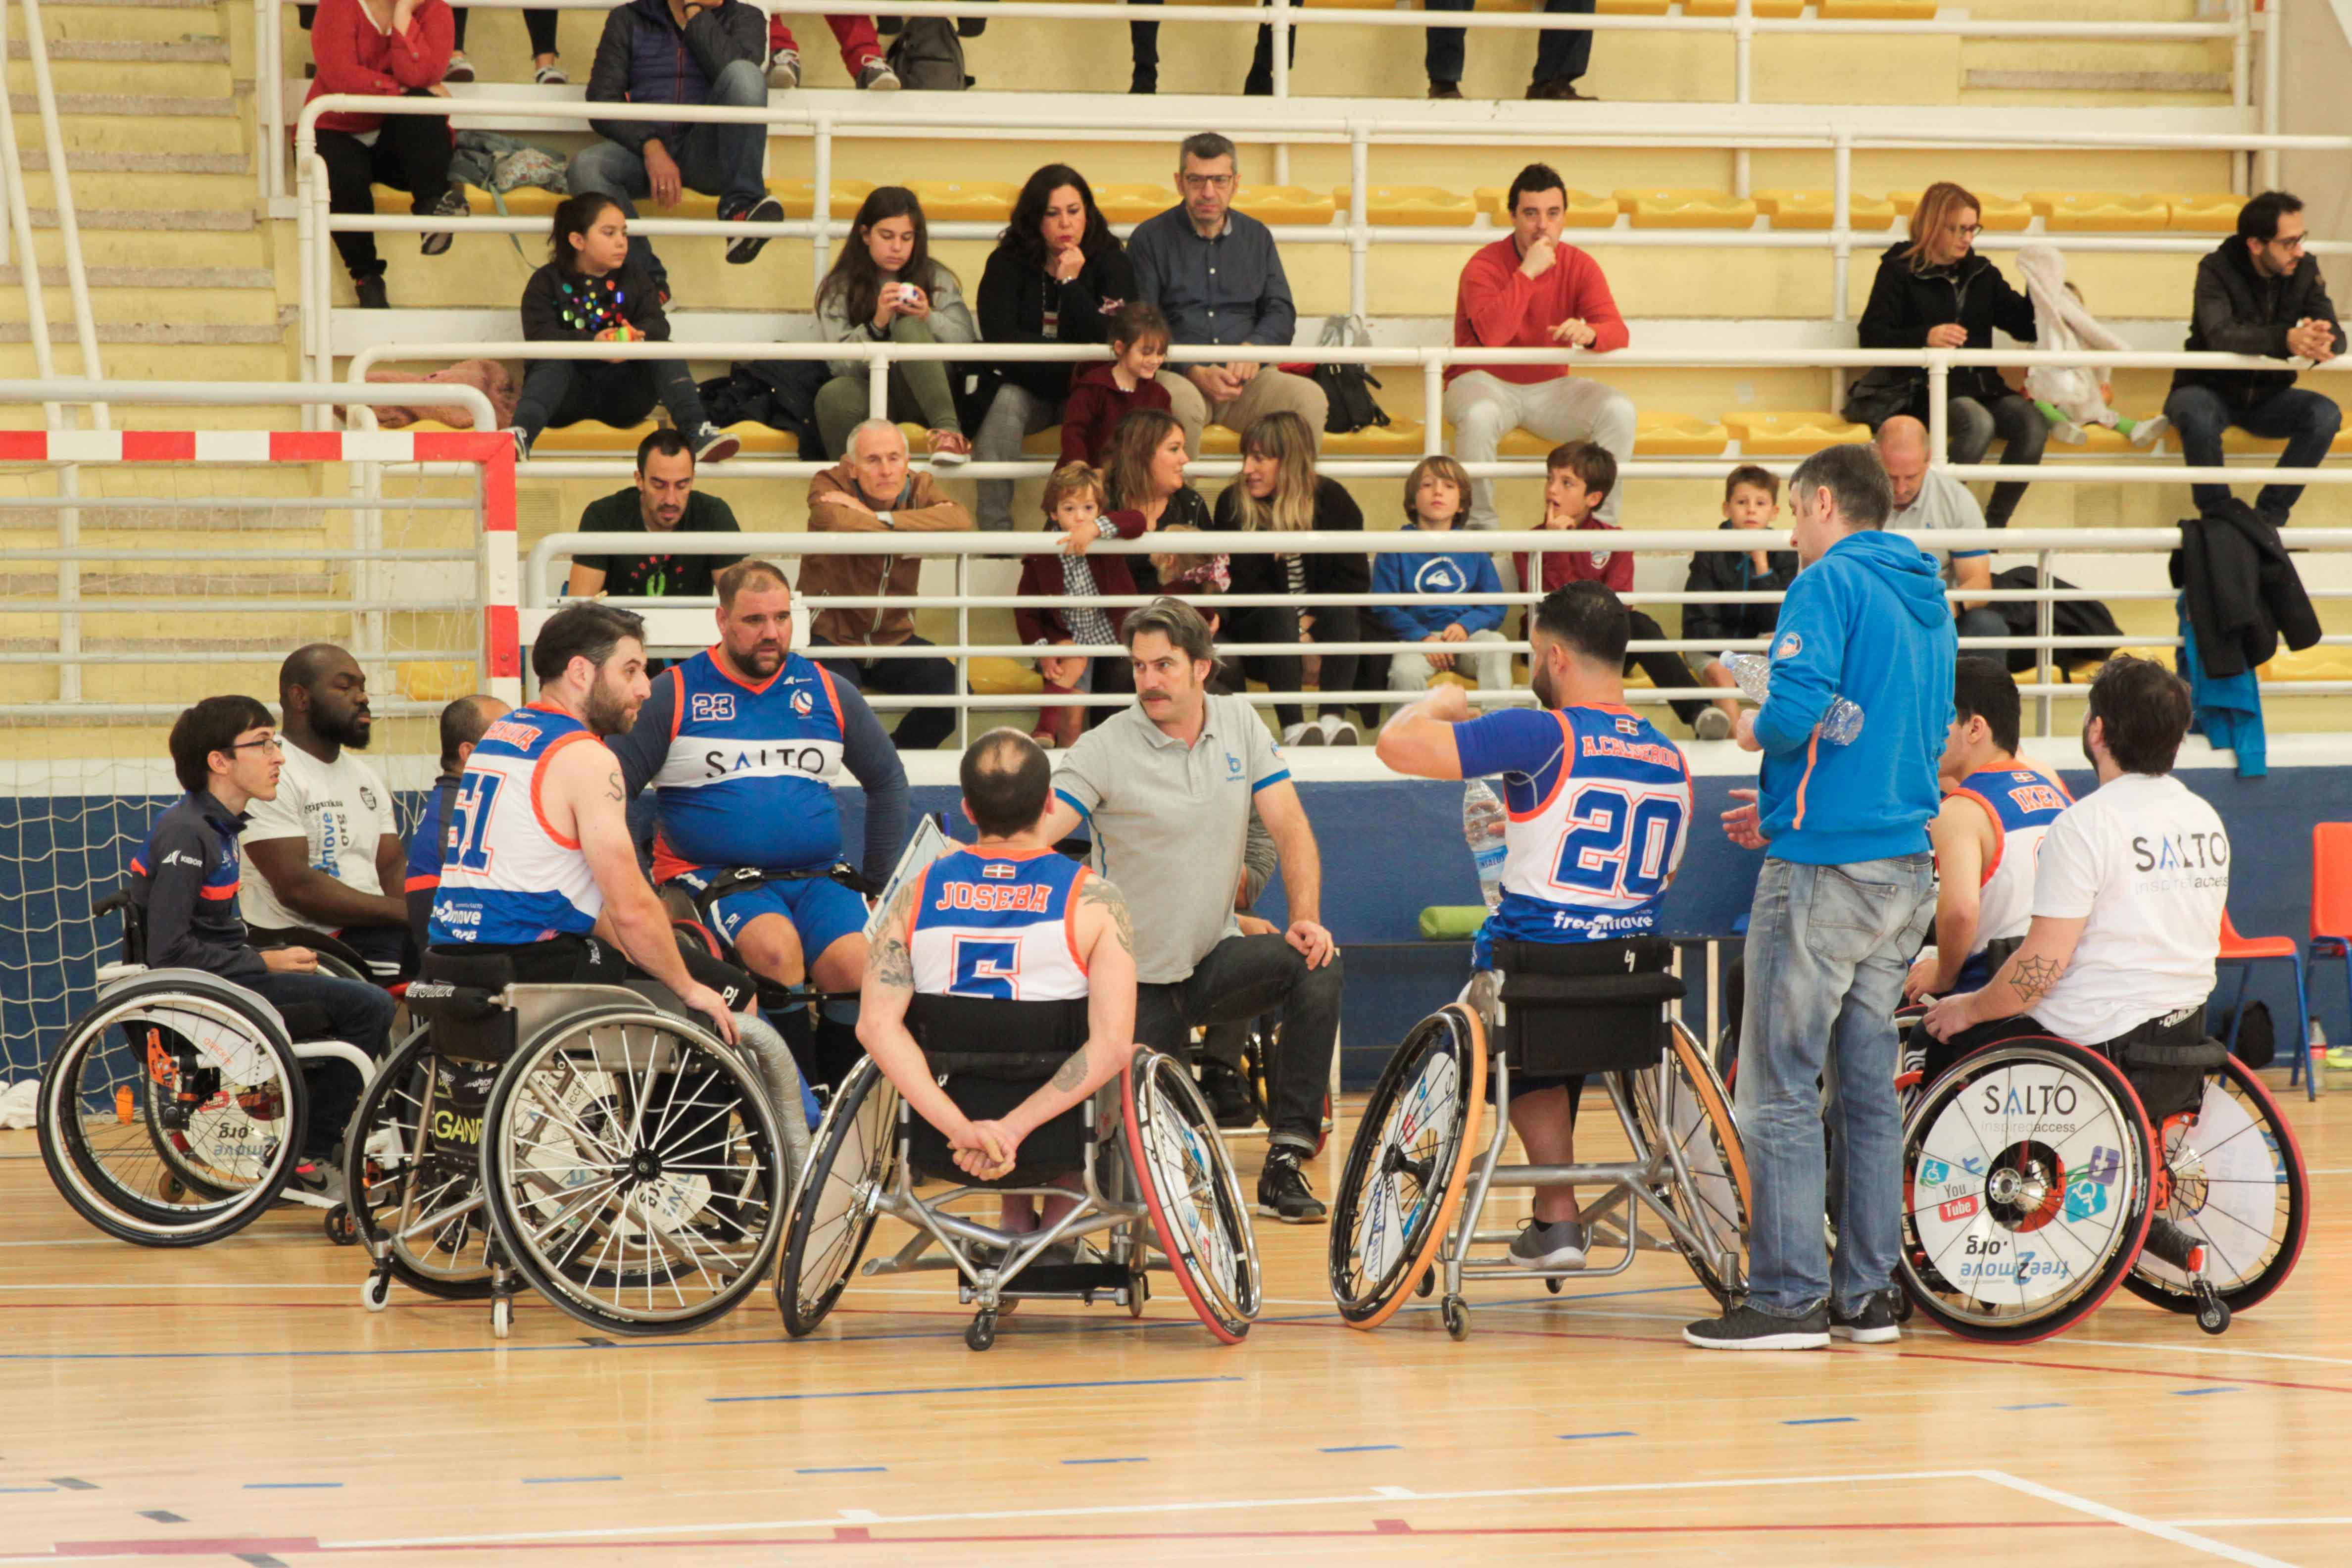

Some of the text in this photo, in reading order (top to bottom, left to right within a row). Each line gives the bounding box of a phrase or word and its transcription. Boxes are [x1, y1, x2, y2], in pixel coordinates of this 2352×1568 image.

[692, 693, 735, 721] 23
[1548, 784, 1686, 900] 20
[2132, 832, 2226, 873] SALTO
[936, 882, 1053, 914] JOSEBA
[1984, 1085, 2076, 1116] SALTO
[1944, 1183, 1966, 1198] You
[1944, 1201, 1971, 1217] Tube
[1960, 1251, 2068, 1285] free2move
